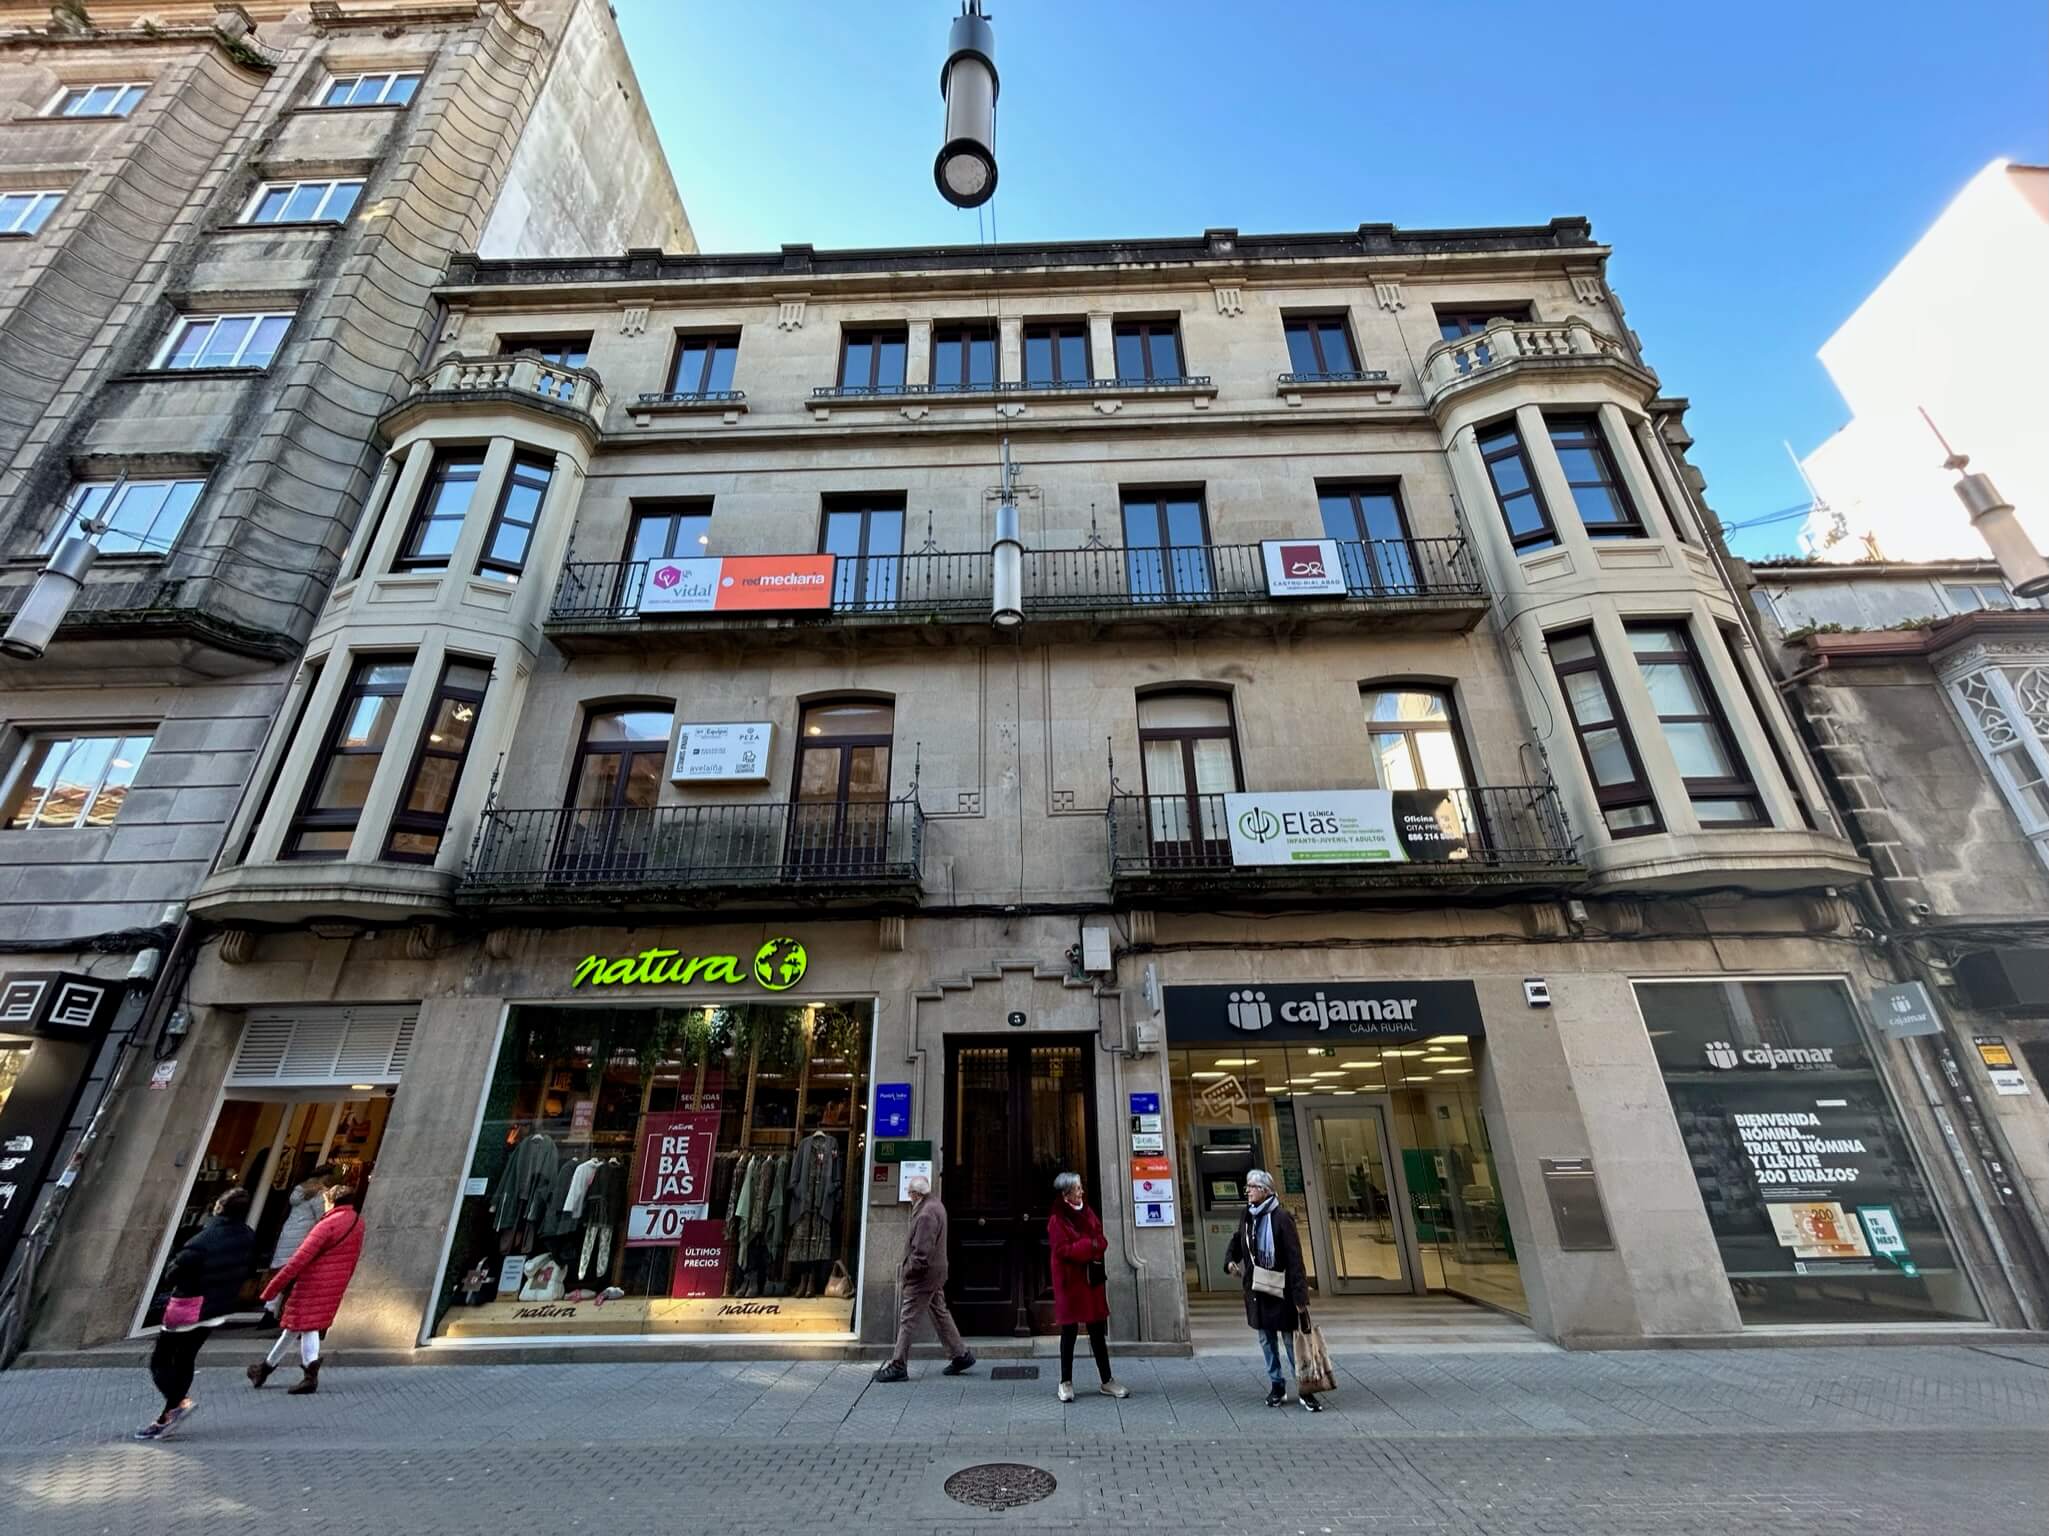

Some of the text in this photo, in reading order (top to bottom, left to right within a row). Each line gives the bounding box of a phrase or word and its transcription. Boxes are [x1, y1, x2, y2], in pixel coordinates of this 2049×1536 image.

[742, 572, 825, 586] redmediaria
[673, 584, 712, 597] vidal
[1282, 811, 1339, 835] Elas
[1404, 815, 1434, 823] Oficina
[1406, 824, 1424, 832] CITA
[1355, 835, 1387, 843] ADULTOS
[1424, 833, 1439, 841] 214
[571, 948, 748, 989] natura
[1280, 992, 1418, 1031] cajamar
[1888, 1013, 1927, 1026] cajamar
[1349, 1022, 1418, 1033] CAJA RURAL
[1742, 1043, 1833, 1070] cajamar
[680, 1094, 721, 1102] SEGNDAS
[684, 1103, 715, 1111] REAJAS
[1734, 1113, 1821, 1127] BIENVENIDA
[661, 1136, 690, 1154] RE
[1744, 1137, 1867, 1154] TRAE TU NÓMINA
[658, 1155, 690, 1175] BA
[1748, 1151, 1822, 1169] Y LLÉVATE
[1755, 1170, 1787, 1183] 200
[653, 1176, 694, 1200] JAS
[1812, 1208, 1834, 1221] 200
[685, 1246, 721, 1256] ÚLTIMOS
[684, 1259, 719, 1268] PRECIOS
[512, 1304, 577, 1319] natura
[717, 1302, 781, 1316] natura
